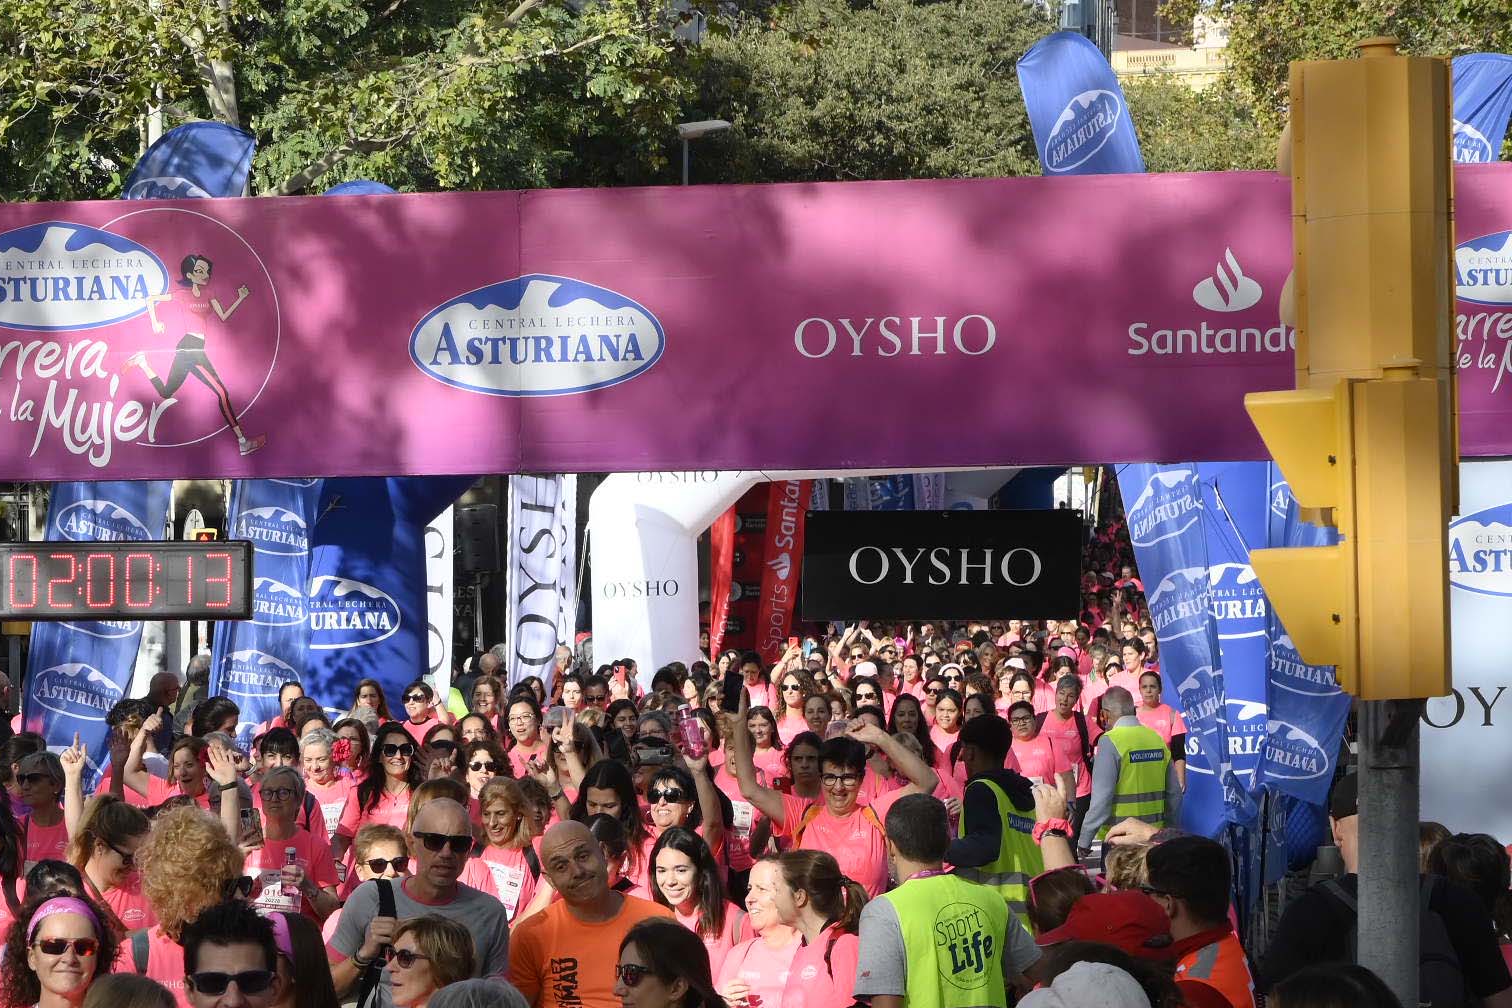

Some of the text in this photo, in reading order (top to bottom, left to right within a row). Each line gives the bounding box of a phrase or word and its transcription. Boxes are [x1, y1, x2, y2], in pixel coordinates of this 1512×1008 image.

[71, 257, 144, 270] LECHERA
[469, 315, 637, 331] CENTRAL LECHERA
[794, 314, 996, 358] OYSHO
[429, 322, 645, 367] ASTURIANA
[1478, 342, 1496, 369] la
[10, 384, 35, 422] la
[29, 374, 177, 467] Mujer
[238, 519, 308, 549] ASTURIANA
[848, 546, 1042, 587] OYSHO
[603, 579, 679, 597] OYSHO
[762, 584, 788, 652] Sports
[935, 908, 984, 948] Sport
[948, 930, 993, 975] Life
